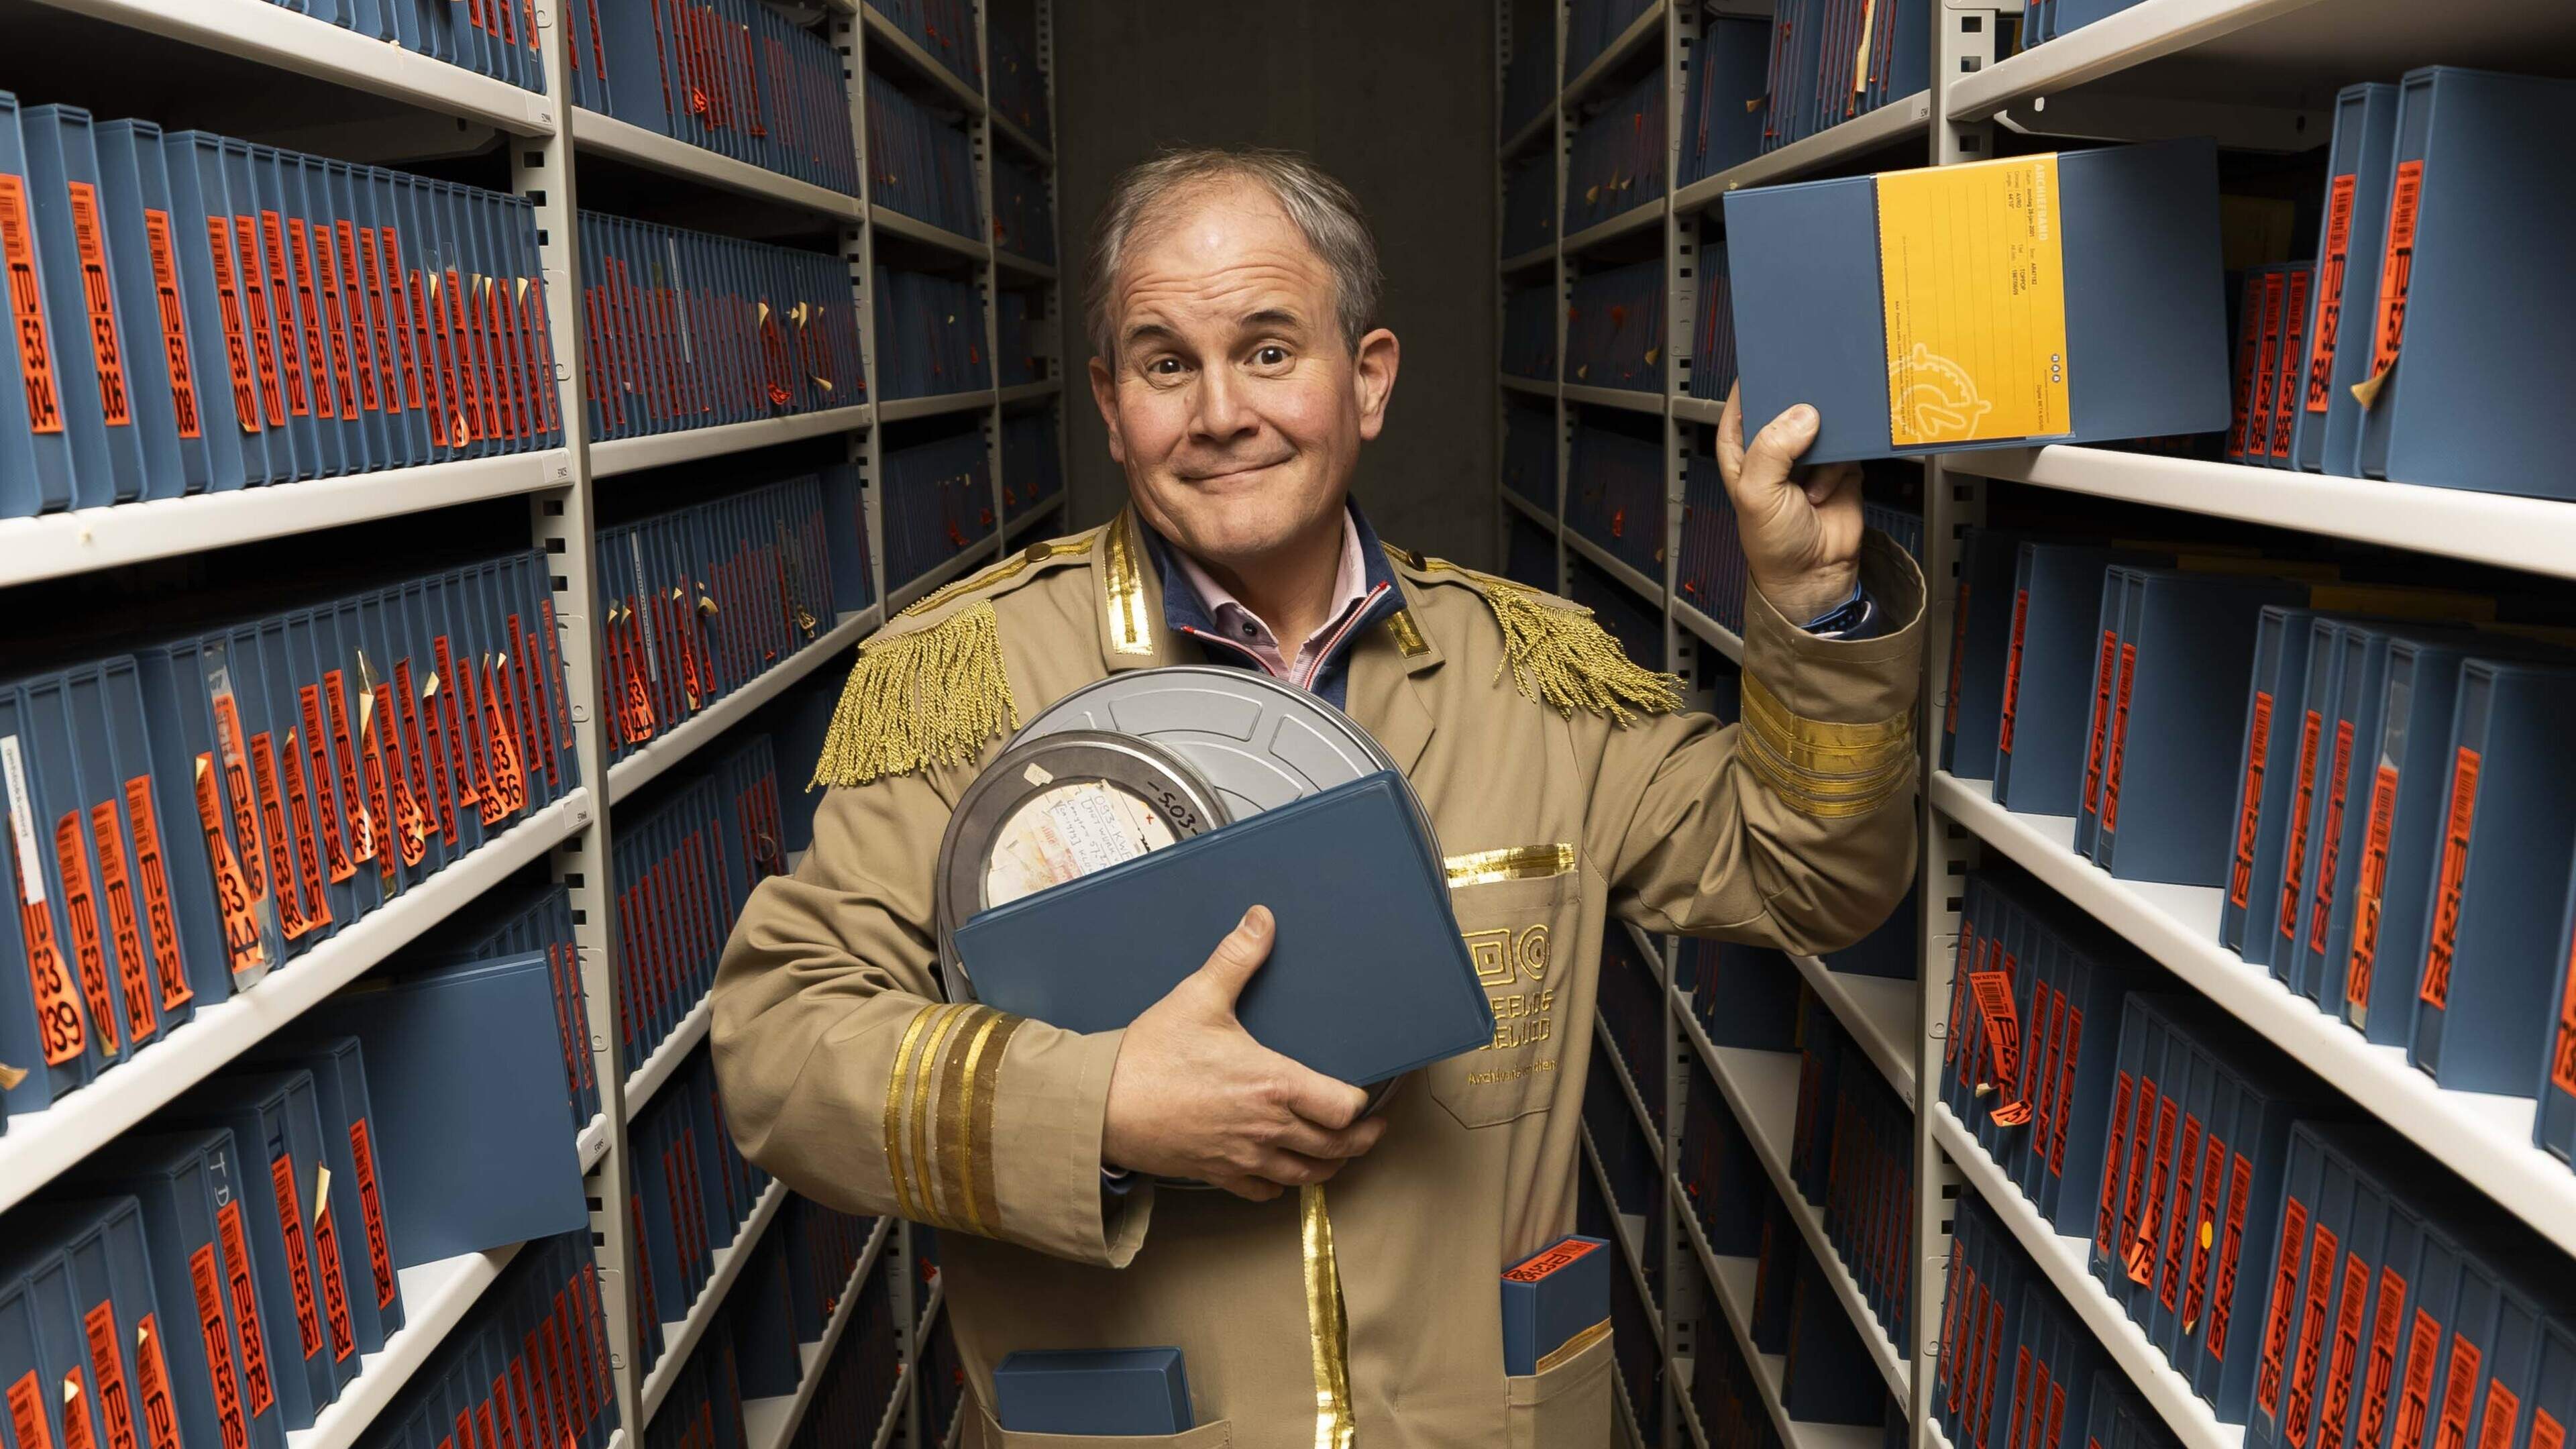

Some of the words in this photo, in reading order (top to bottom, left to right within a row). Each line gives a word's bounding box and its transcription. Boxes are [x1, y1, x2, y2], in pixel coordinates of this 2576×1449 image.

[2035, 164, 2049, 241] ARCHIEFBAND
[12, 264, 36, 312] TD
[85, 264, 107, 312] TD
[2332, 254, 2345, 299] TD
[2396, 248, 2412, 296] TD
[160, 287, 178, 332] TD
[221, 289, 239, 333] TD
[248, 286, 266, 327] TD
[274, 278, 290, 319] TD
[299, 286, 315, 326] TD
[325, 291, 343, 330] TD
[347, 282, 363, 322] TD
[370, 289, 385, 327] TD
[391, 286, 407, 323] TD
[23, 319, 45, 368] 53
[95, 317, 115, 364] 53
[281, 323, 297, 364] 53
[354, 325, 369, 363] 53
[376, 327, 392, 368] 53
[398, 325, 413, 364] 53
[2323, 306, 2339, 352] 52
[2386, 303, 2406, 351] 52
[168, 337, 187, 381] 53
[229, 337, 248, 378] 53
[256, 332, 274, 373] 53
[308, 330, 323, 369] 53
[333, 333, 348, 373] 53
[2260, 375, 2273, 411] 52
[2284, 375, 2296, 411] 52
[2310, 359, 2334, 402] 694
[405, 716, 419, 750] TD
[485, 704, 499, 737] TD
[313, 750, 329, 790] TD
[337, 735, 352, 771] TD
[365, 753, 381, 790] TD
[386, 743, 401, 778] TD
[492, 739, 511, 773] 53
[228, 764, 247, 806] TD
[343, 775, 359, 814] 53
[397, 782, 413, 819] 53
[2253, 765, 2263, 809] TD
[265, 800, 284, 845] TD
[292, 793, 308, 837] TD
[321, 792, 335, 832] 53
[371, 793, 387, 831] 53
[207, 827, 227, 869] TD
[2243, 811, 2258, 857] 52
[141, 852, 162, 897] TD
[274, 845, 290, 888] 53
[300, 837, 316, 877] 53
[2453, 837, 2468, 889] TD
[71, 893, 93, 945] TD
[109, 879, 131, 929] TD
[151, 902, 172, 949] 53
[2442, 892, 2461, 947] 52
[34, 947, 62, 999] 53
[81, 945, 103, 996] 53
[119, 930, 140, 979] 53
[1478, 1018, 1551, 1051] ELUID
[1992, 1016, 2016, 1047] TD
[2002, 1048, 2018, 1086] 52
[362, 1181, 377, 1222] TD
[2180, 1181, 2192, 1221] TD
[286, 1222, 303, 1267] TD
[318, 1228, 334, 1271] TD
[370, 1220, 384, 1260] 53
[1546, 1253, 1572, 1265] TD
[2170, 1221, 2186, 1262] 52
[2229, 1223, 2241, 1265] TD
[294, 1265, 310, 1308] 53
[1503, 1269, 1541, 1281] 085
[1528, 1262, 1556, 1274] 53
[2221, 1267, 2237, 1311] 52
[233, 1273, 251, 1318] TD
[326, 1269, 341, 1311] 53
[2281, 1269, 2296, 1319] TD
[207, 1315, 225, 1364] TD
[242, 1317, 260, 1362] 53
[2273, 1315, 2288, 1366] 52
[2310, 1300, 2325, 1350] TD
[2302, 1346, 2318, 1397] 52
[2341, 1330, 2357, 1383] TD
[2375, 1345, 2392, 1400] TD
[216, 1361, 234, 1407] 53
[2331, 1379, 2348, 1432] 52
[104, 1381, 126, 1432] TD
[148, 1391, 170, 1441] TD
[2367, 1397, 2385, 1448] 52
[2407, 1391, 2425, 1448] TD
